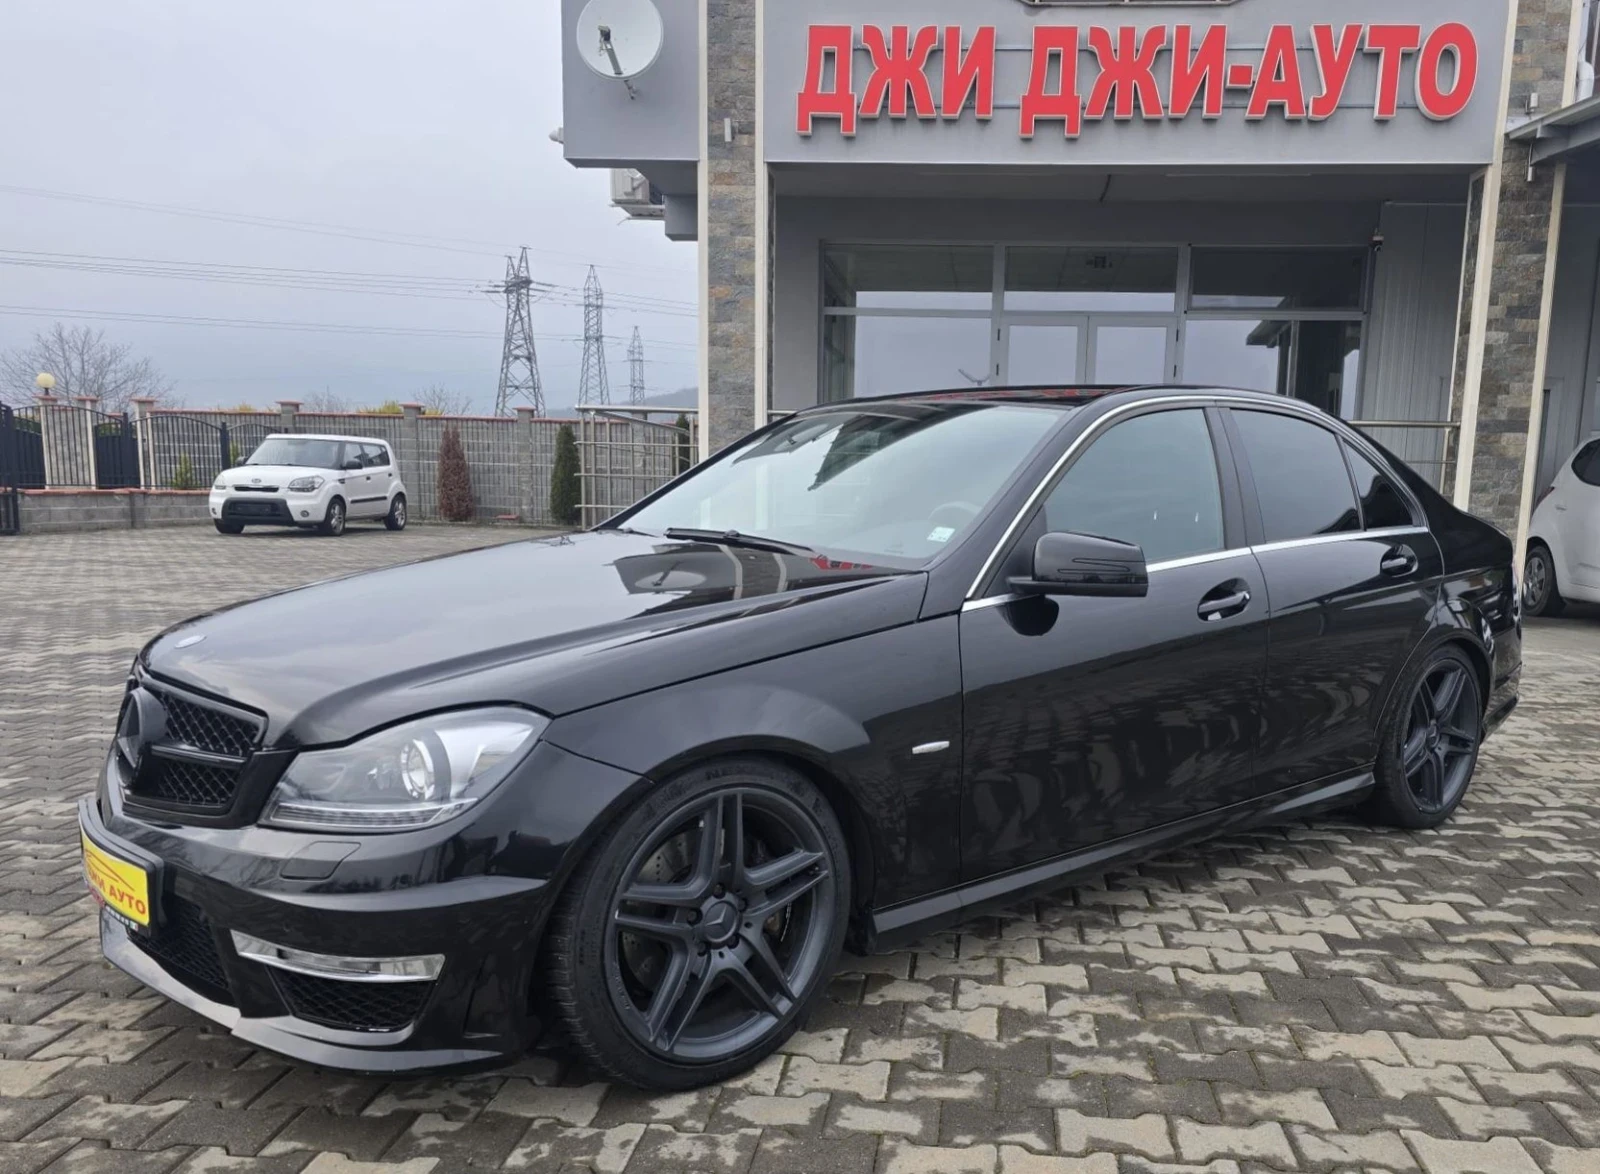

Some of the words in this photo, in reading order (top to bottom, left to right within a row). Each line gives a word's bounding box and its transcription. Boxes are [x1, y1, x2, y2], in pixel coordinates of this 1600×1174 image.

[796, 24, 996, 136] ДЖИ
[1019, 22, 1479, 139] ДЖИ-АУТО
[109, 885, 146, 915] АУТО
